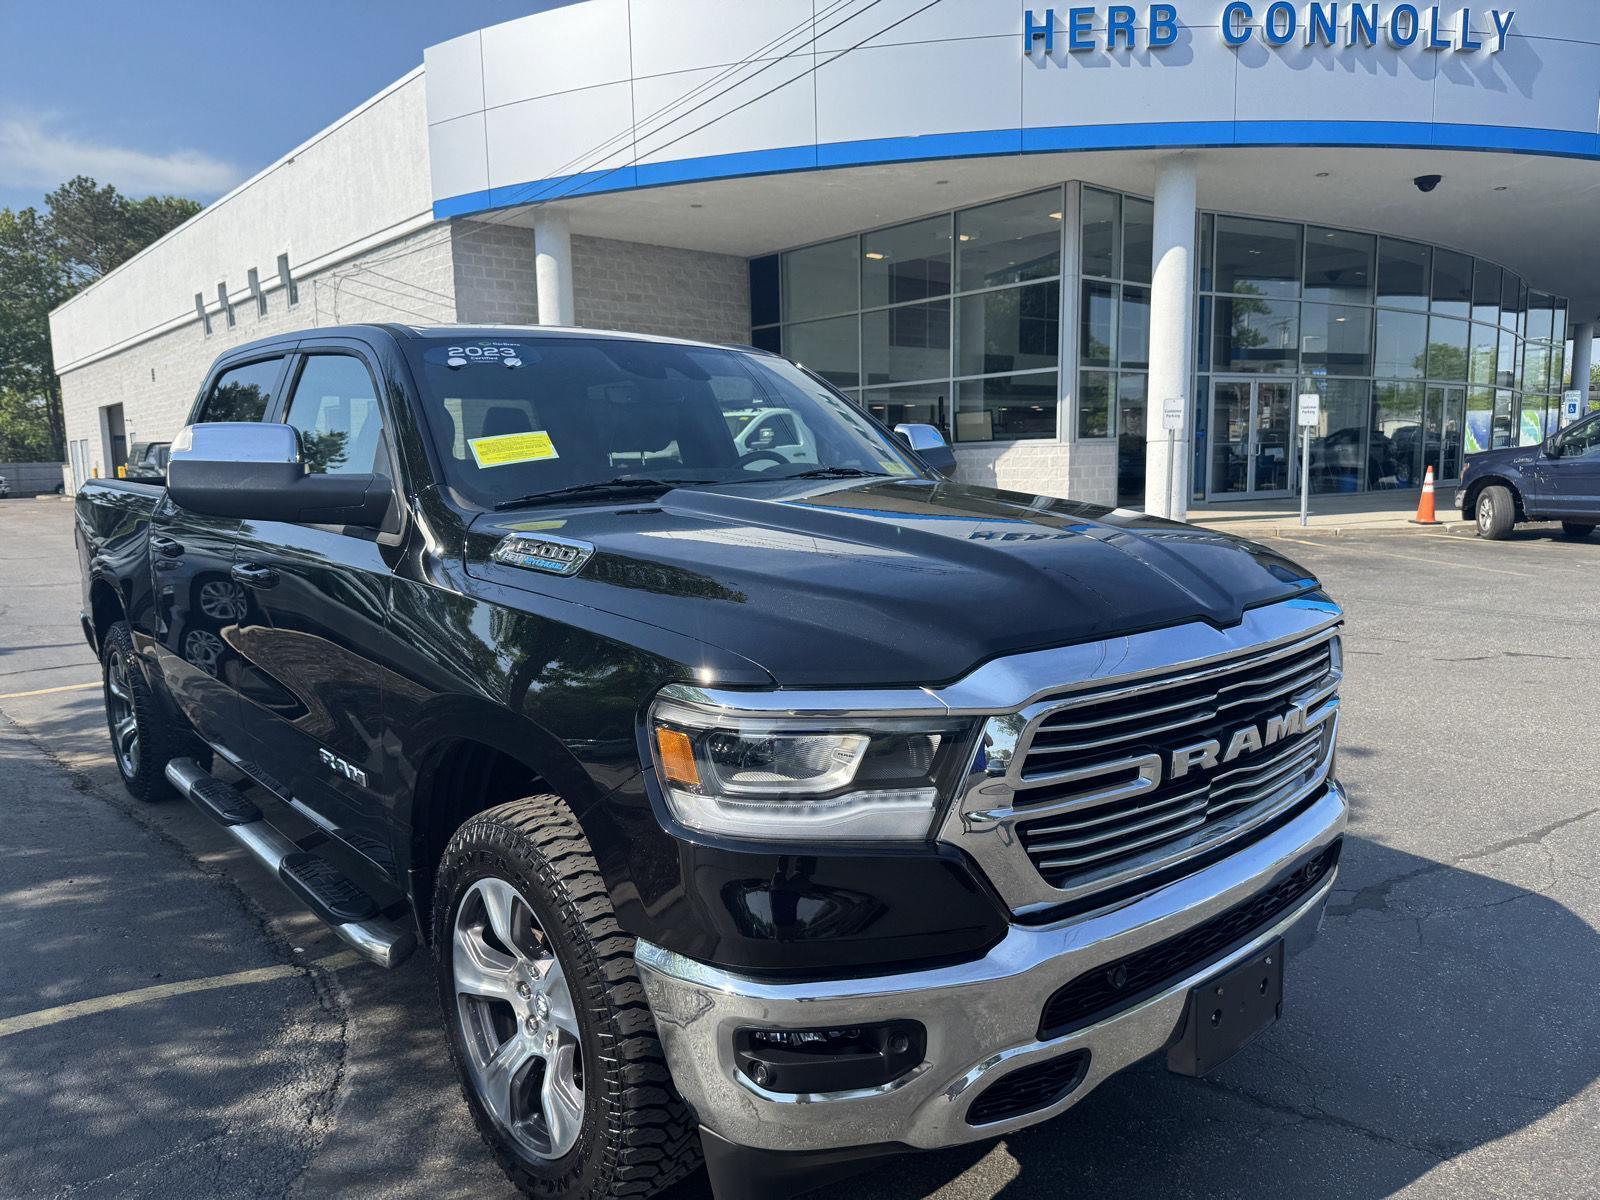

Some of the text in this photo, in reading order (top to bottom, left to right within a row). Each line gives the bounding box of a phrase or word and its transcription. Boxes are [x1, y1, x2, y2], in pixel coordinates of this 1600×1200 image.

[1024, 1, 1515, 54] HERB CONNOLLY
[447, 346, 517, 357] 2023
[1170, 707, 1302, 780] RAM
